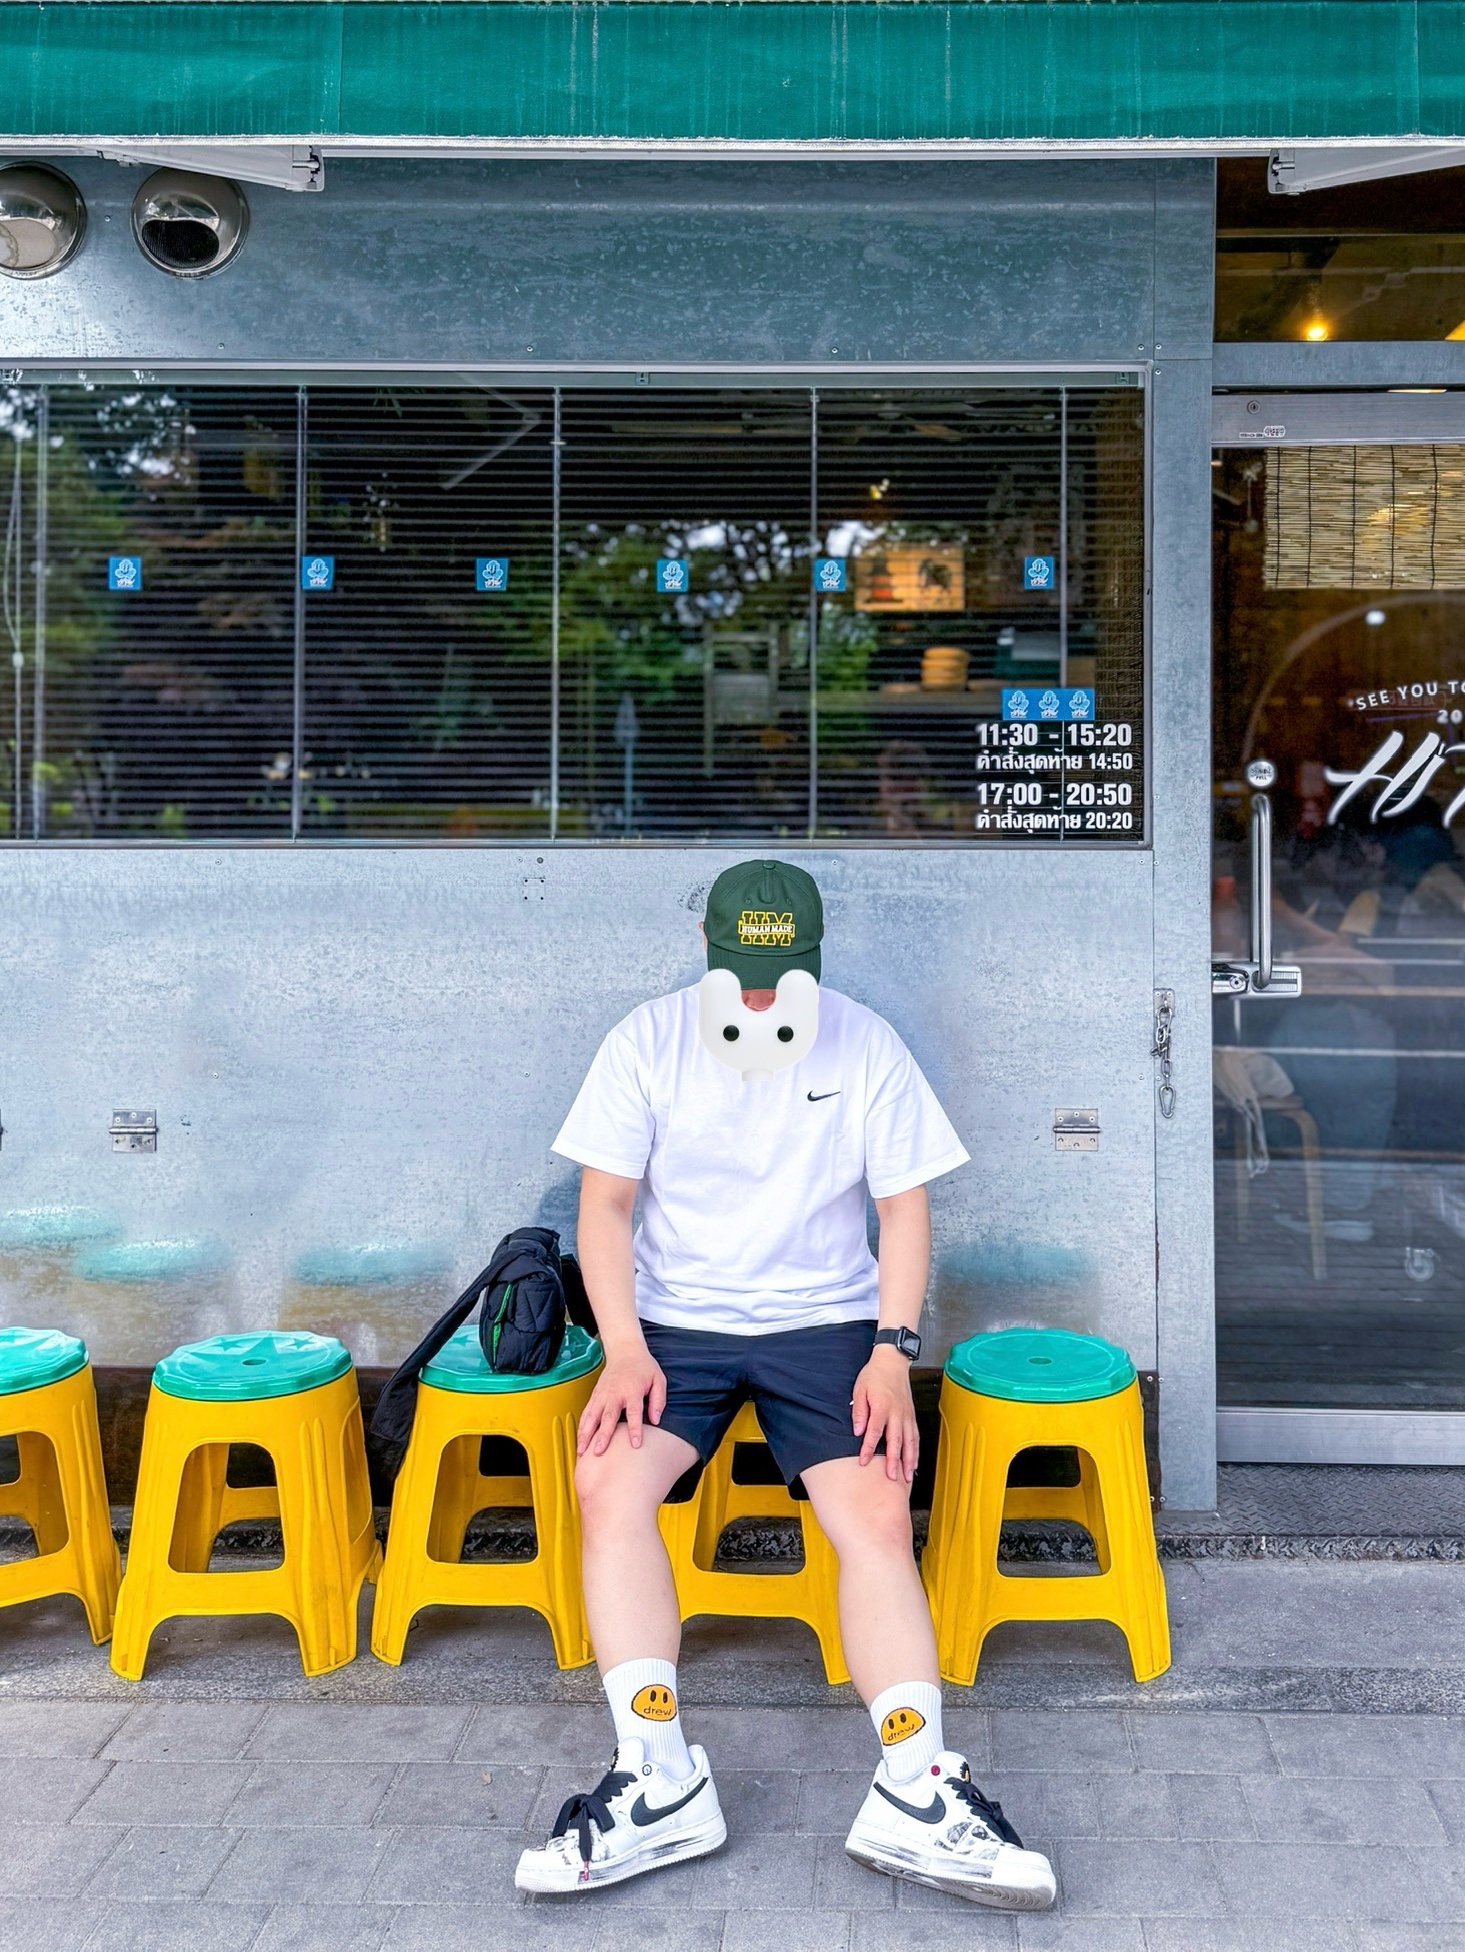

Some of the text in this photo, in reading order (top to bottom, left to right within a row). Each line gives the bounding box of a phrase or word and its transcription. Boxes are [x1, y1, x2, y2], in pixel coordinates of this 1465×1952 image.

[1355, 689, 1390, 711] SEE
[1396, 681, 1438, 700] YOU
[977, 723, 1038, 746] 11:30
[1067, 723, 1132, 746] 15:20
[1088, 752, 1133, 770] 14:50
[977, 783, 1042, 805] 17:00
[1066, 783, 1132, 805] 20:50
[1085, 812, 1133, 829] 20:20
[741, 924, 793, 934] HUMAN MADE
[643, 1705, 672, 1716] drew
[887, 1723, 915, 1741] drew
